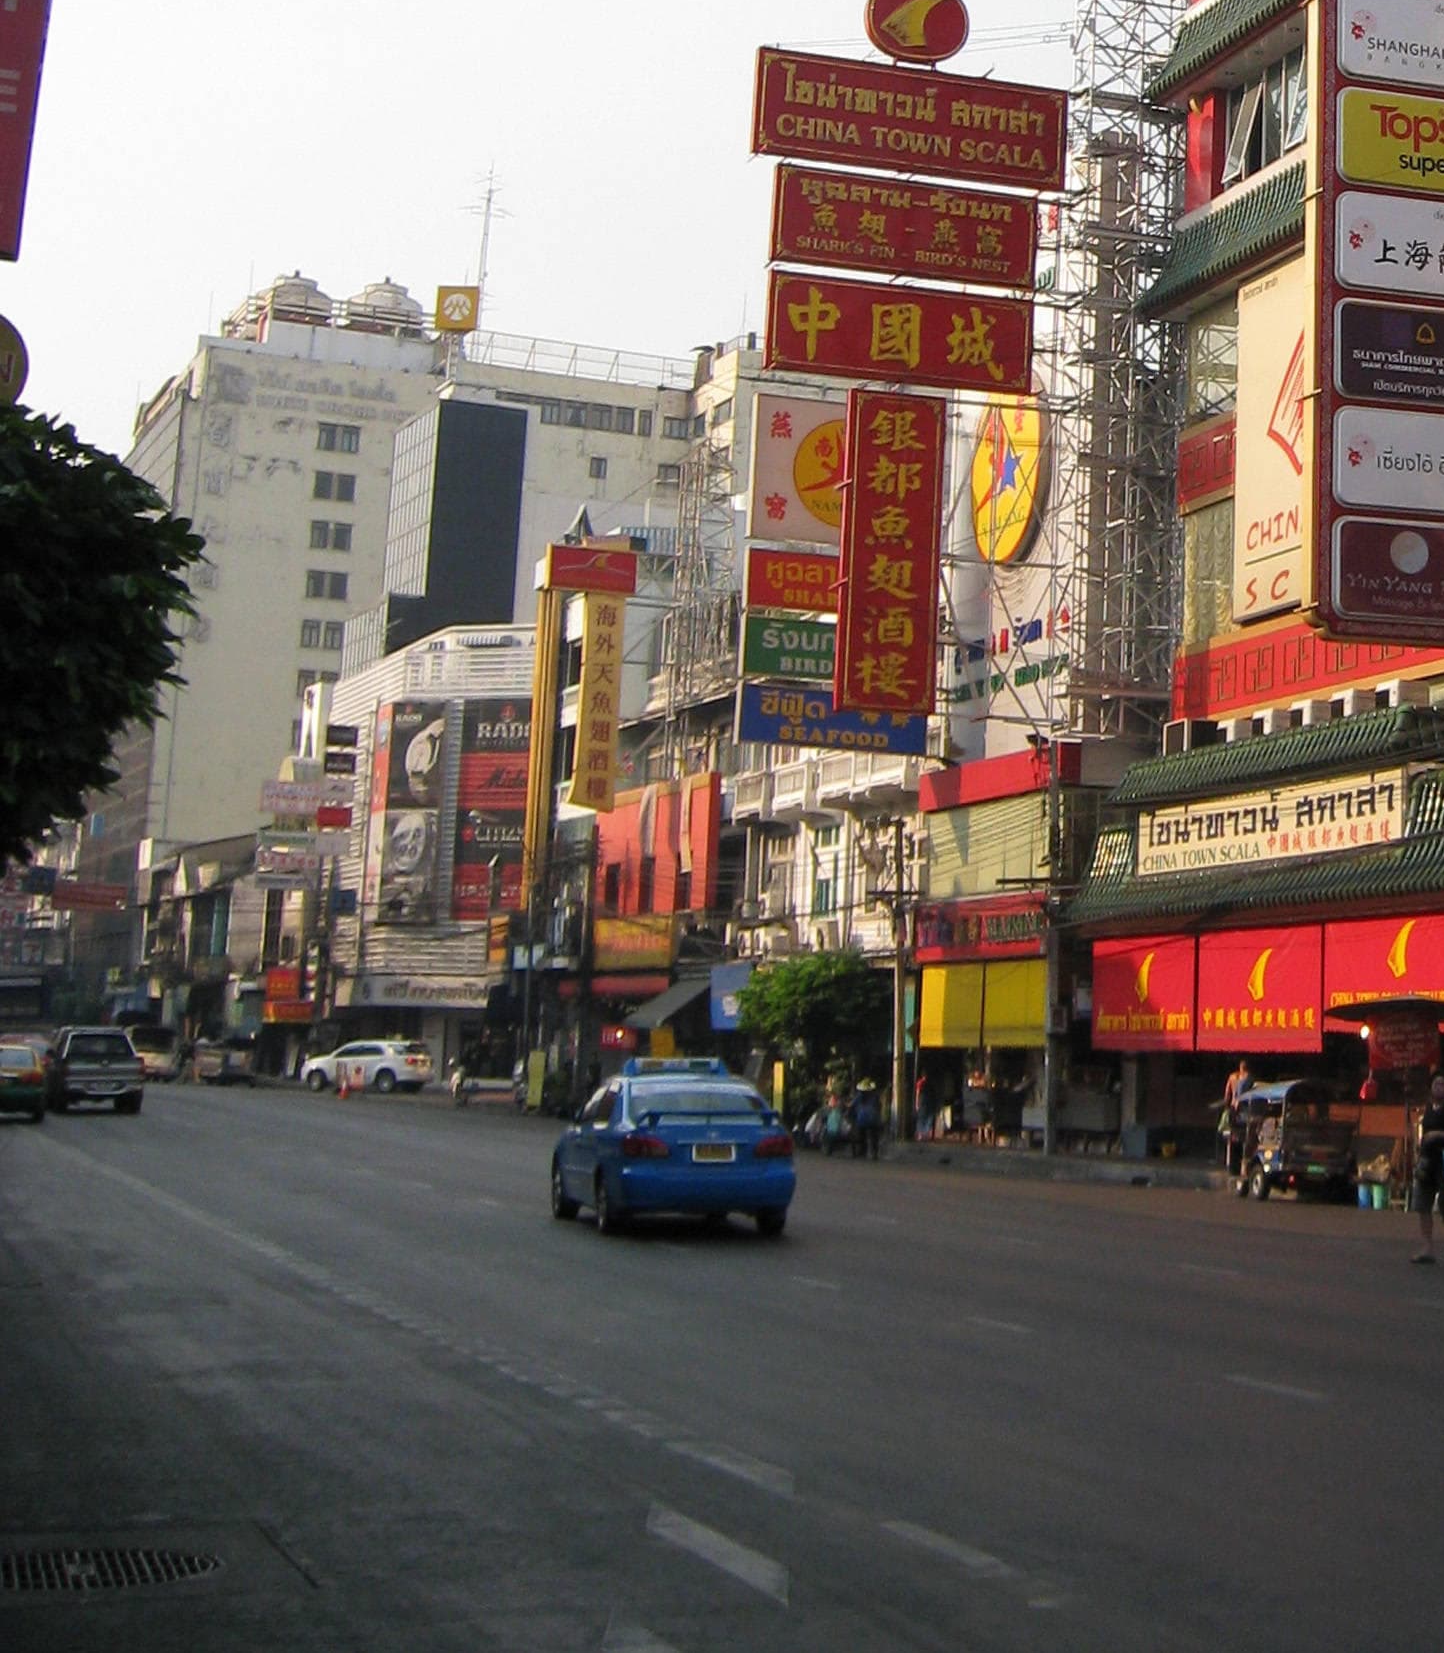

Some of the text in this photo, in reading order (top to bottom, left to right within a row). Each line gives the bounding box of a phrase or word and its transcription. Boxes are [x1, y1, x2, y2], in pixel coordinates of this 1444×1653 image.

[1367, 36, 1444, 60] SHANGHAI
[781, 61, 1046, 137] ไชน่าทาวน์ สกาล่า
[775, 113, 1046, 171] CHINA TOWN SCALA
[809, 203, 888, 243] 魚翅
[796, 236, 864, 256] SHARK'S
[869, 244, 896, 260] FIN
[914, 250, 966, 268] BIRD'S
[971, 258, 1012, 274] NEST
[787, 286, 1004, 382] 中國城
[1246, 504, 1303, 551] CHIN
[855, 409, 927, 699] 銀都魚翅酒樓
[779, 656, 833, 675] BIRD
[778, 725, 889, 748] SEAFOOD
[1143, 842, 1261, 872] CHINA TOWN SCALA
